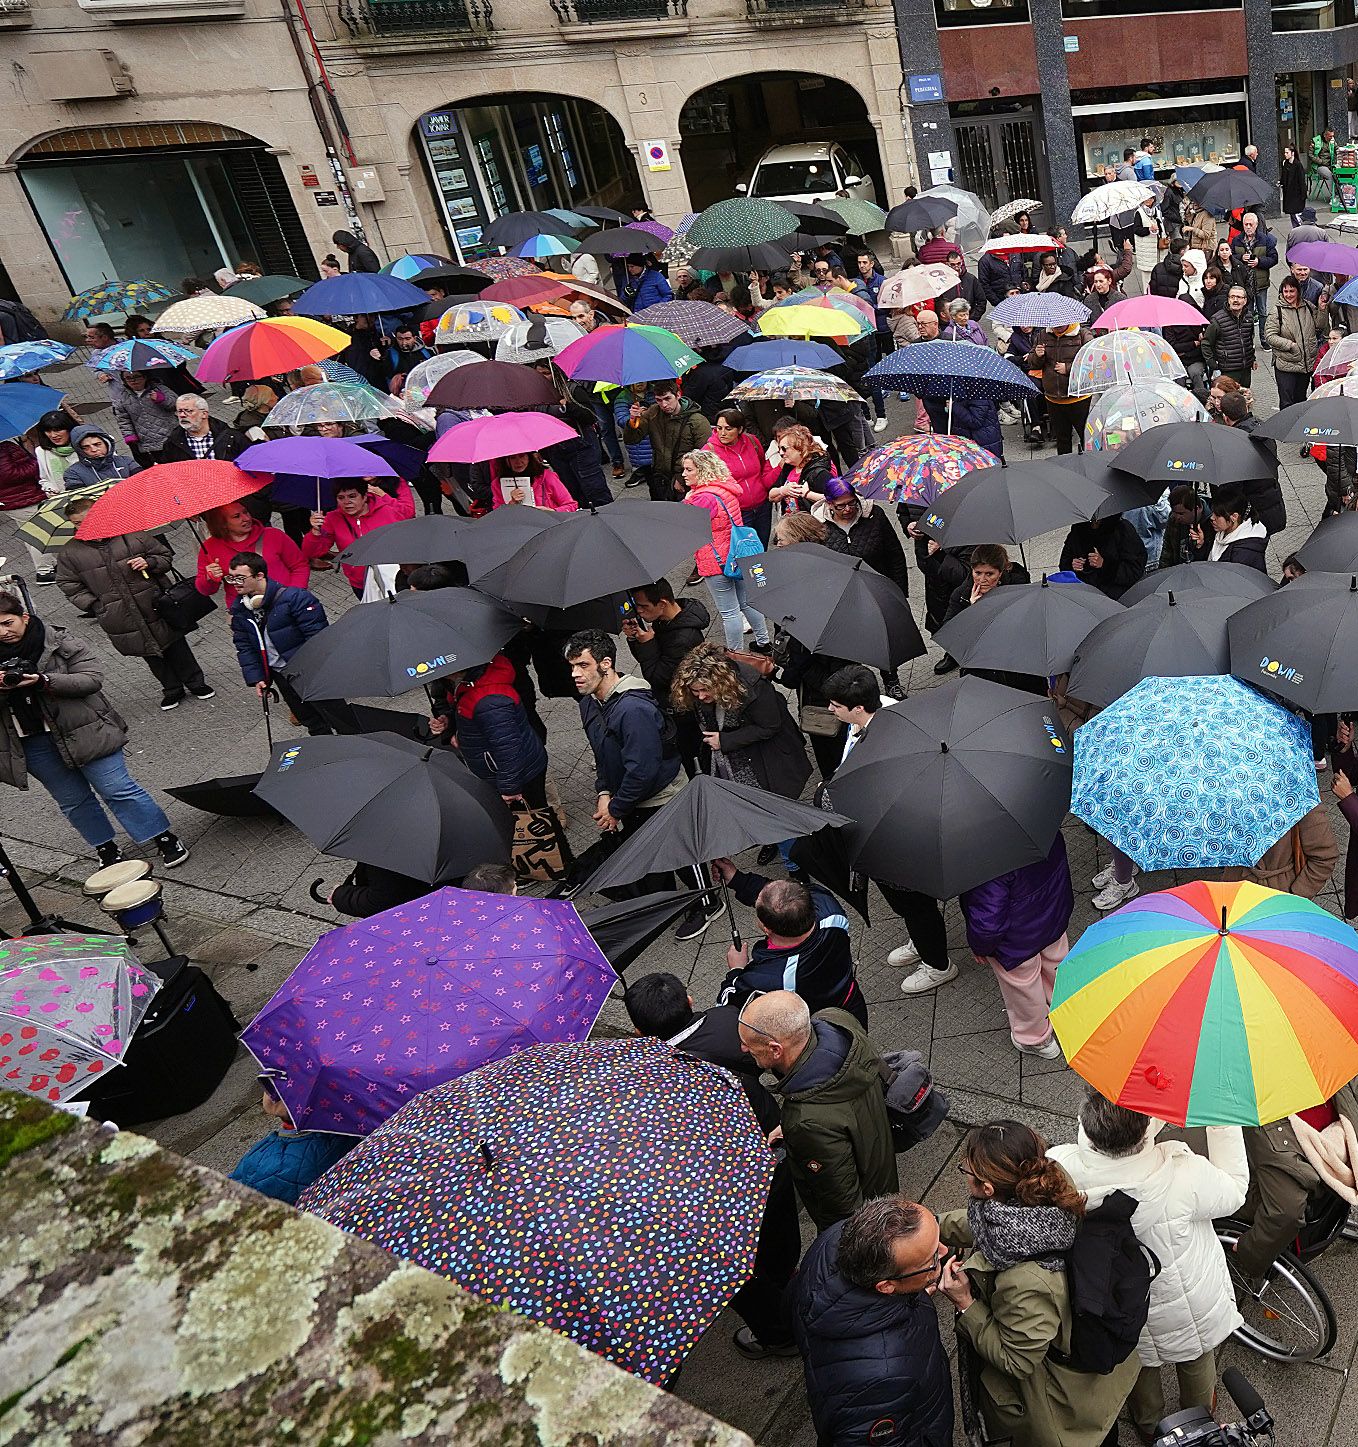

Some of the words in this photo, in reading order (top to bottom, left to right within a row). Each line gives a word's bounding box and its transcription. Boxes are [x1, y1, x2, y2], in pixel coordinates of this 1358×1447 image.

[638, 92, 648, 106] 3
[1303, 427, 1332, 436] DOWN
[1166, 459, 1196, 470] DOWN
[406, 655, 447, 677] DOWN
[1259, 656, 1296, 681] DOWN
